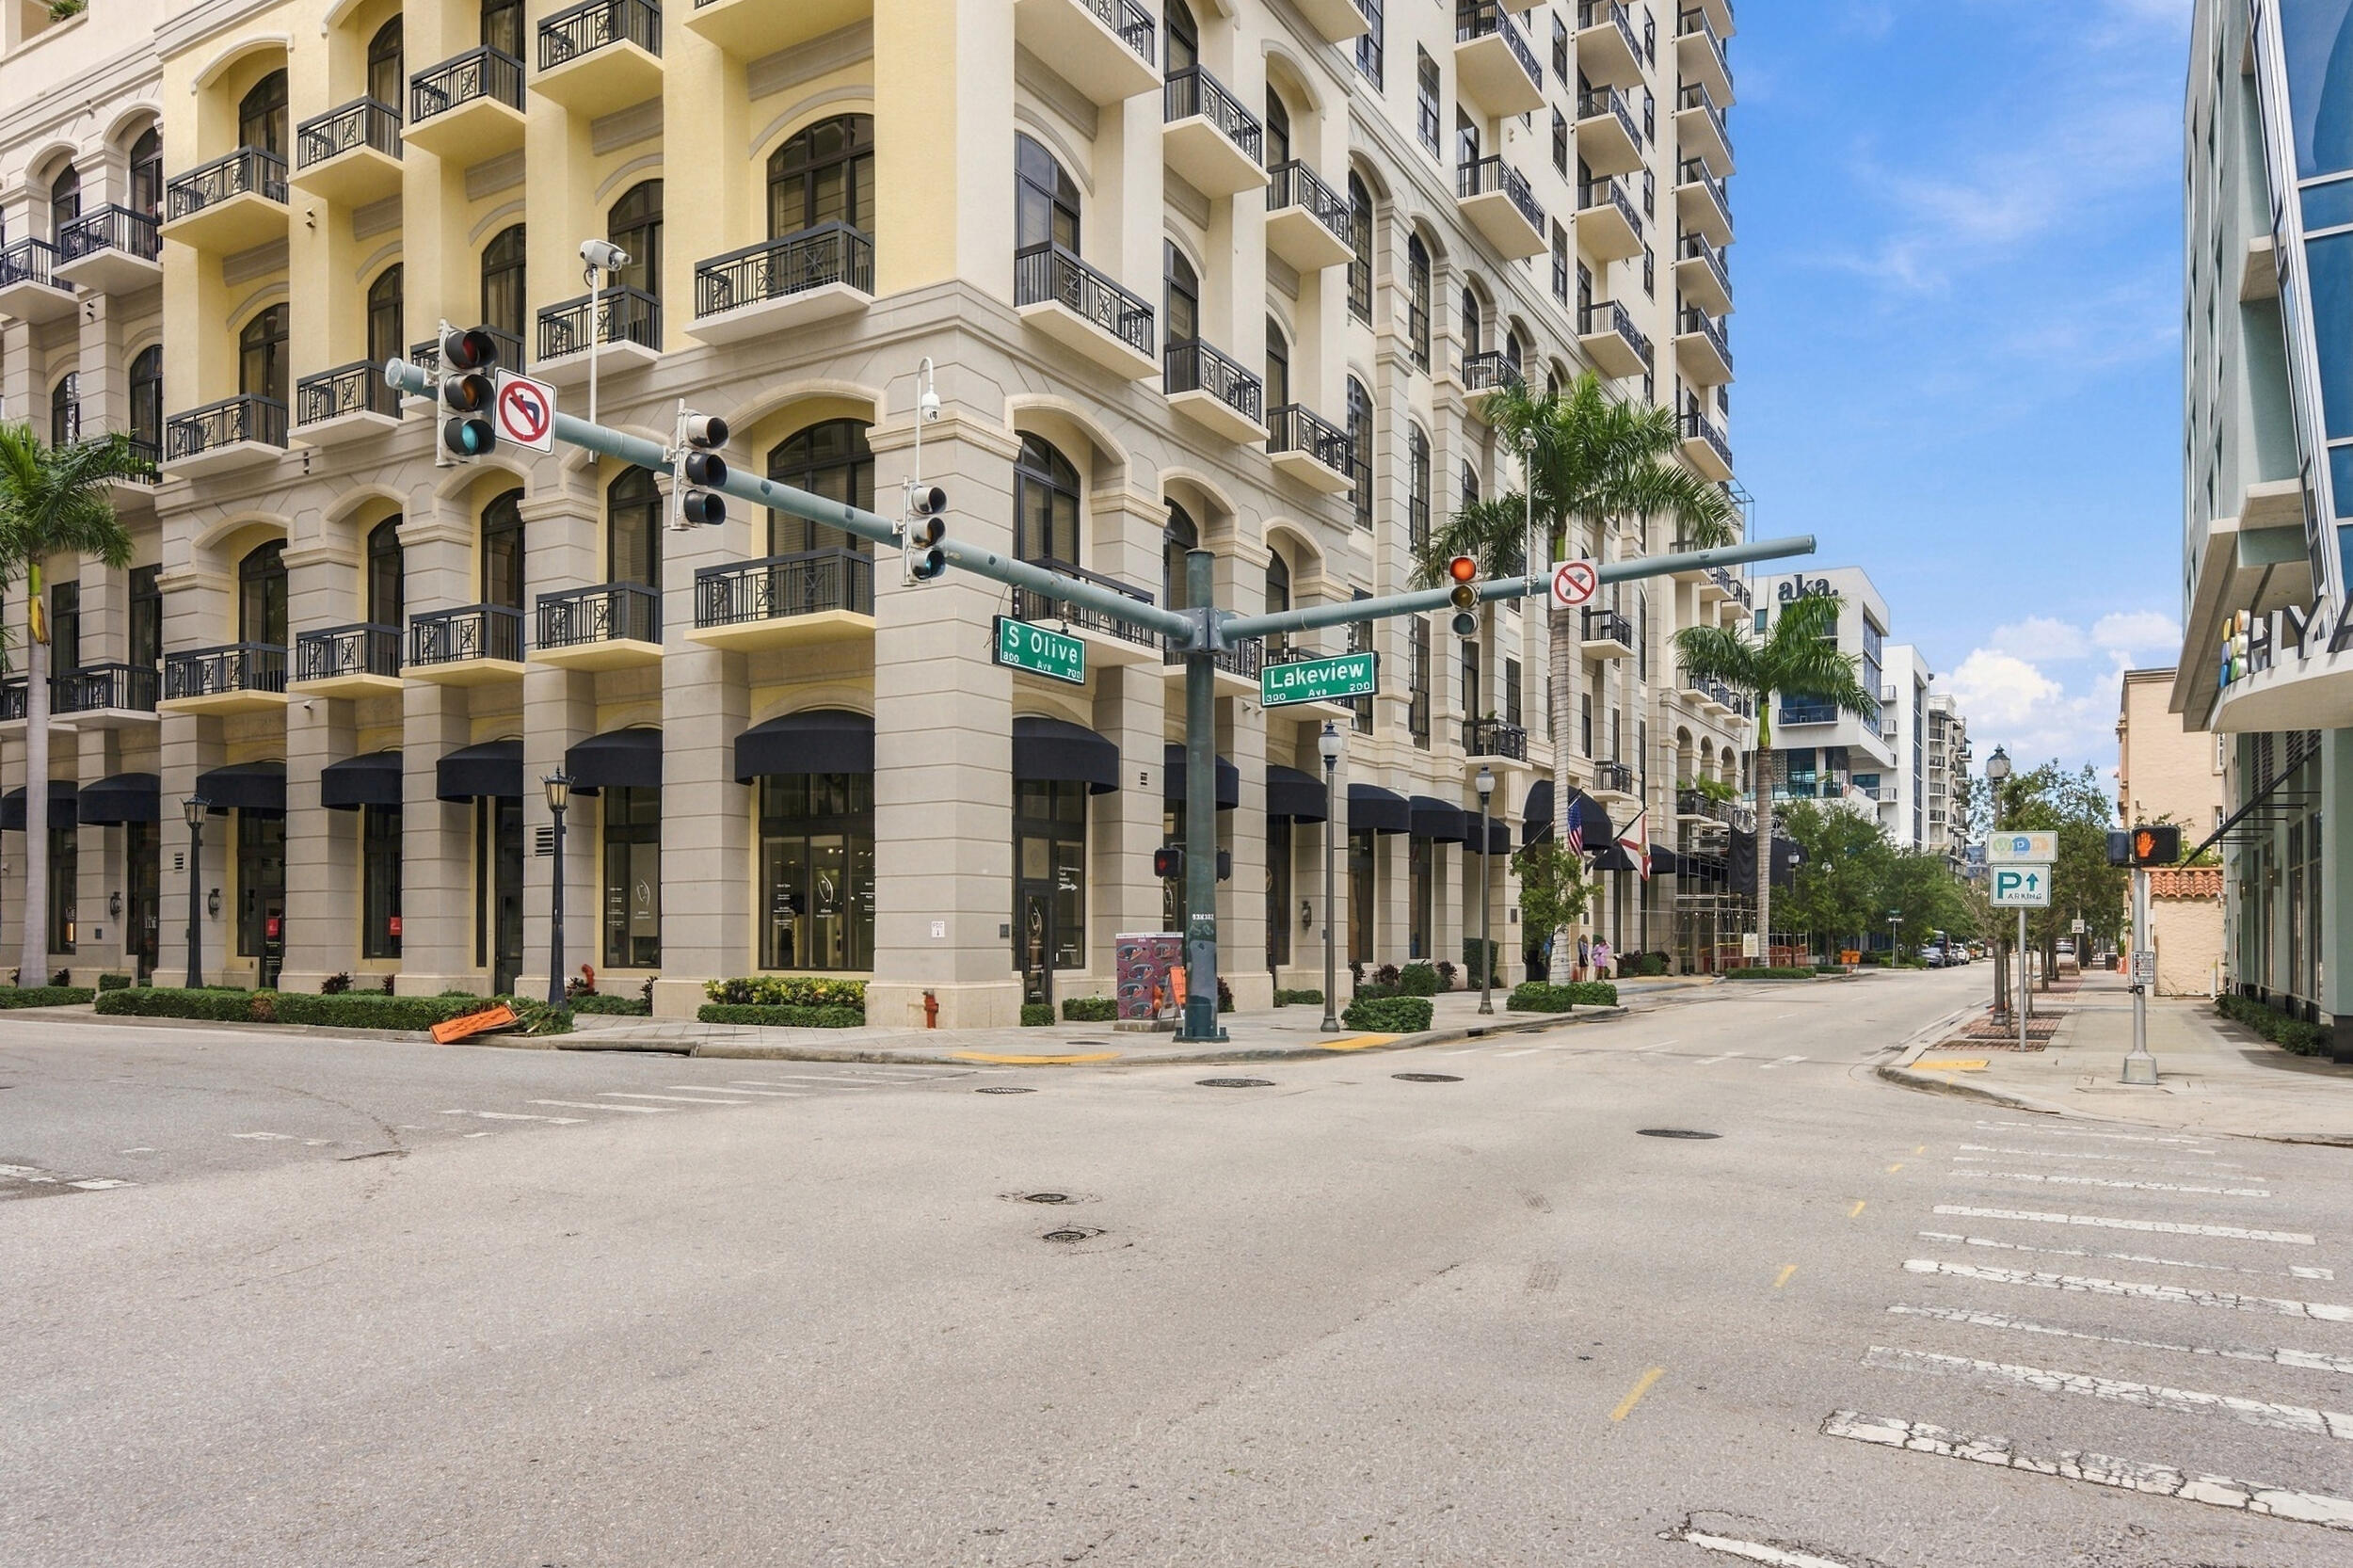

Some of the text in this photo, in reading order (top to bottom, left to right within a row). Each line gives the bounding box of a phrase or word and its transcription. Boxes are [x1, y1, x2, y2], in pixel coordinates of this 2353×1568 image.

[1008, 625, 1078, 664] S Olive
[1002, 651, 1081, 680] 800 Ave 700
[1271, 662, 1365, 689] Lakeview
[1266, 681, 1370, 703] 300 Ave 200
